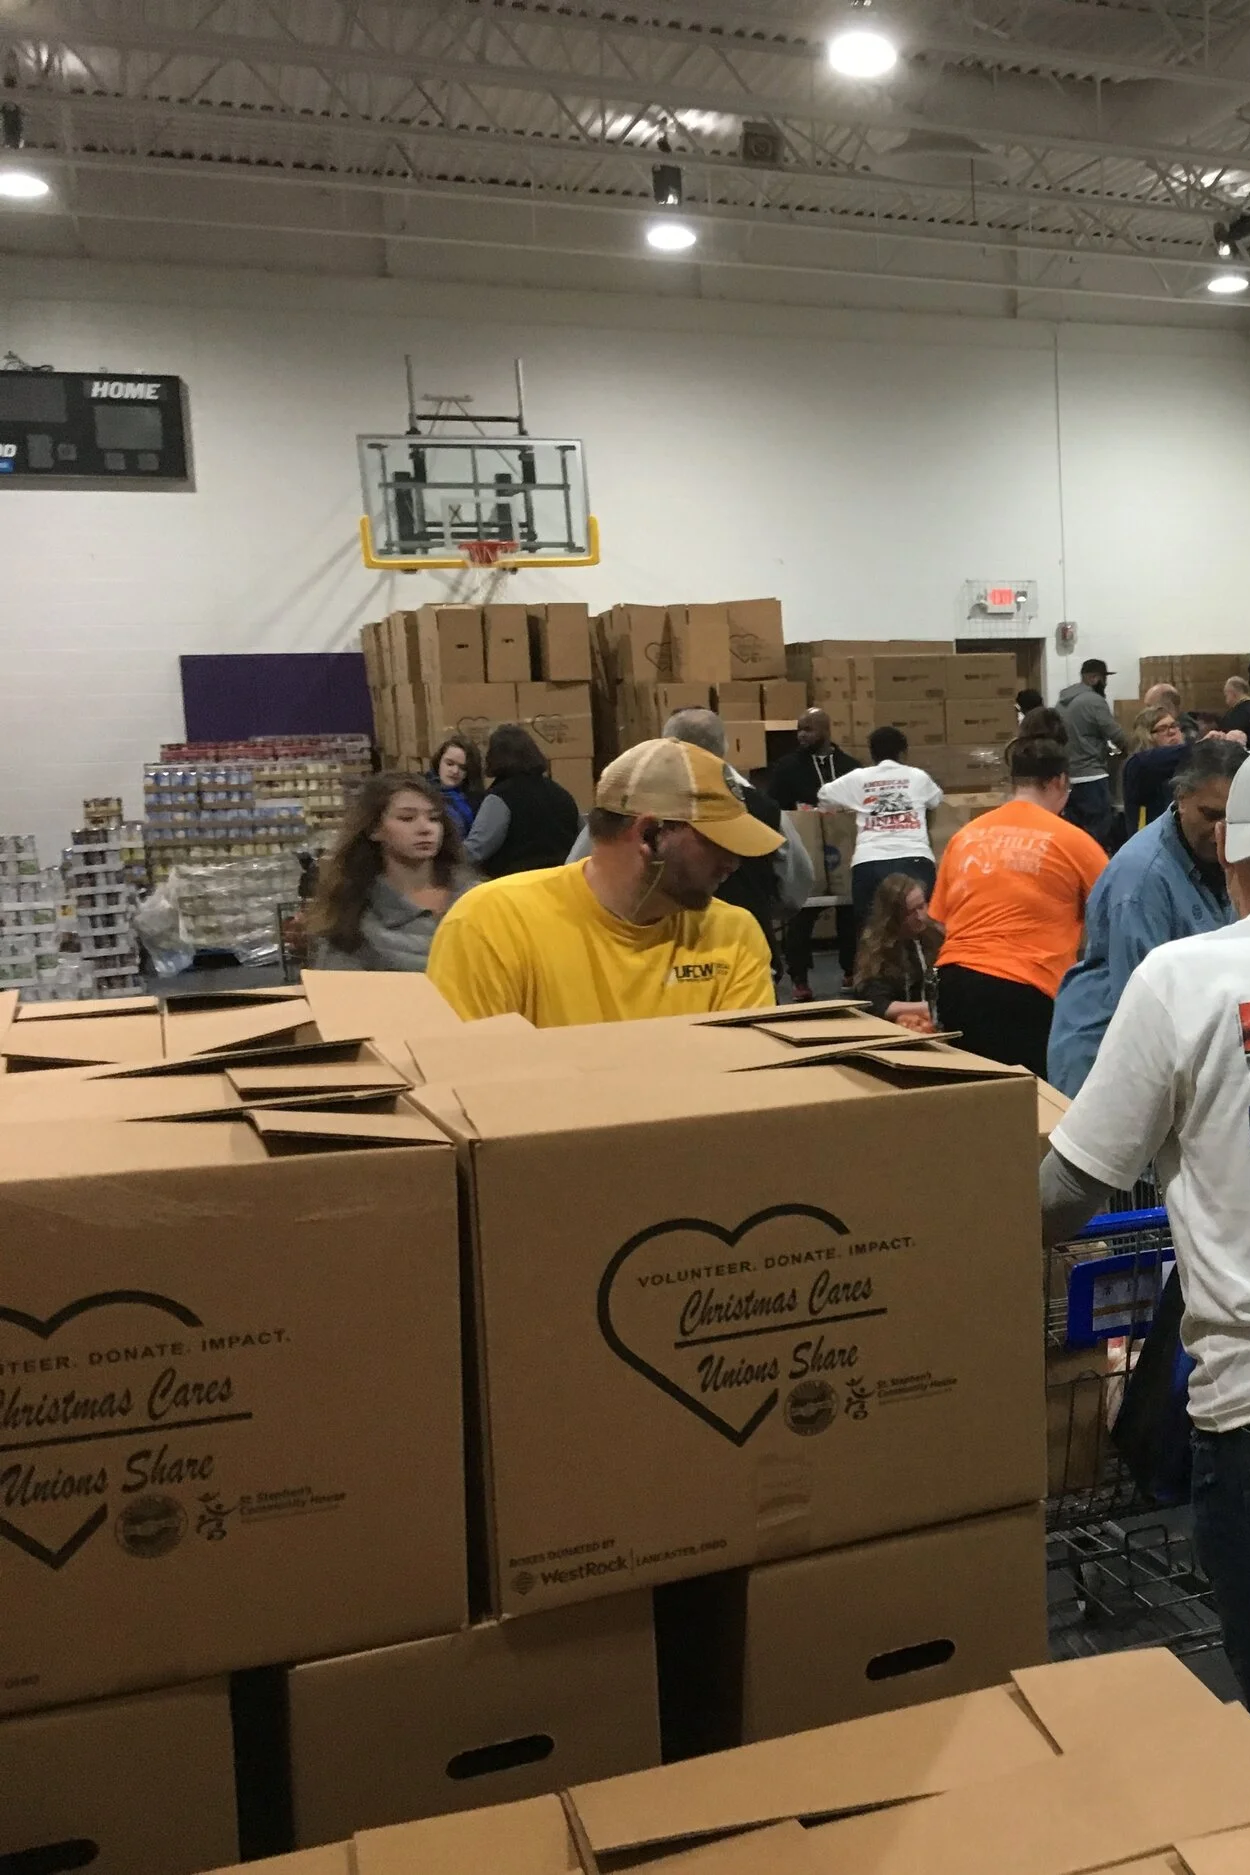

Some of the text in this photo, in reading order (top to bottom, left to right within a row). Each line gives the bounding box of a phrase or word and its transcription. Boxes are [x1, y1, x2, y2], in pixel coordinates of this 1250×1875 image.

[90, 381, 161, 400] HOME
[673, 963, 714, 979] UFCW
[637, 1236, 916, 1288] VOLUNTEER. DONATE. IMPACT.
[679, 1269, 874, 1337] Christmas Cares
[88, 1340, 191, 1366] DONATE.
[201, 1329, 292, 1353] IMPACT.
[696, 1335, 859, 1393] Unions Share
[147, 1367, 235, 1422] Cares
[0, 1444, 215, 1508] Unions Share
[540, 1556, 628, 1585] WestRock
